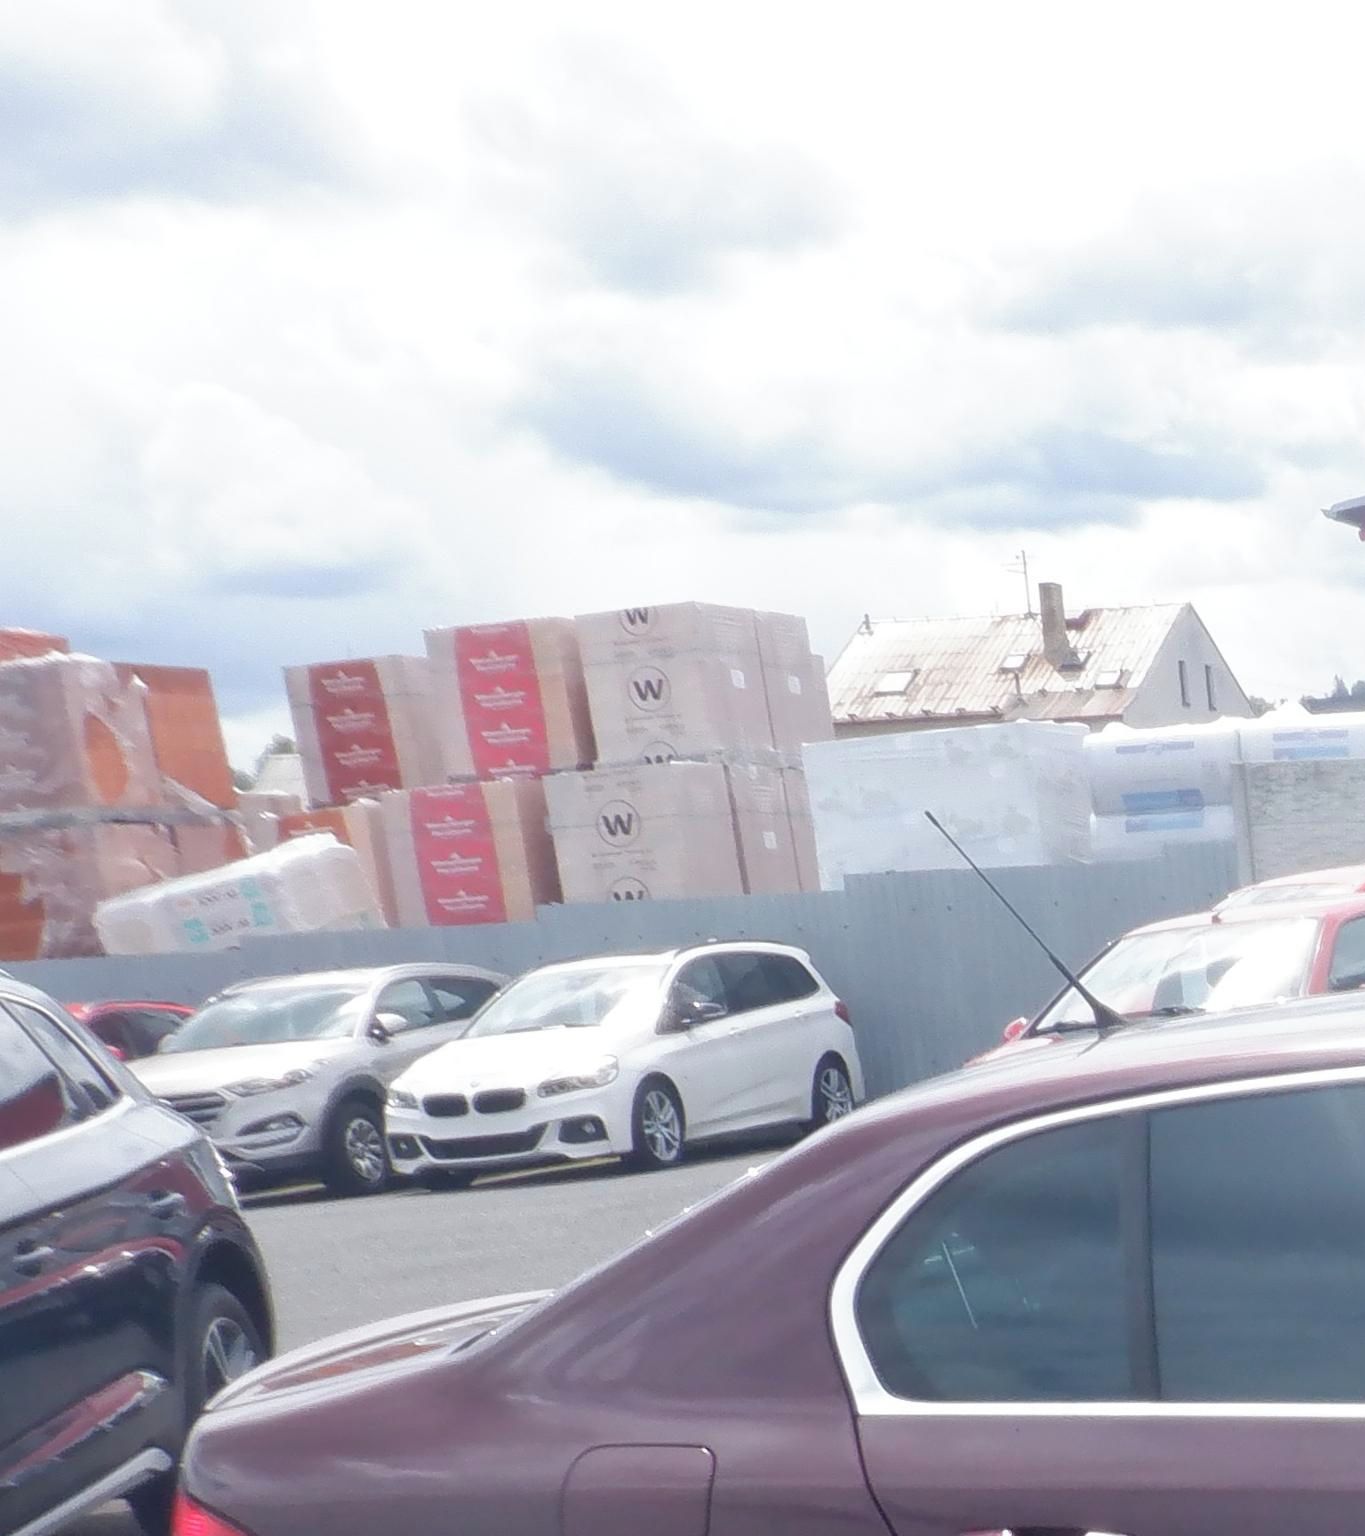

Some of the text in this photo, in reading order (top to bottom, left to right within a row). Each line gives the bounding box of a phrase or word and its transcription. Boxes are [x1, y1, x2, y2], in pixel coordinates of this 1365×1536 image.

[624, 607, 650, 627] W
[633, 678, 663, 701] W
[601, 813, 633, 836] W
